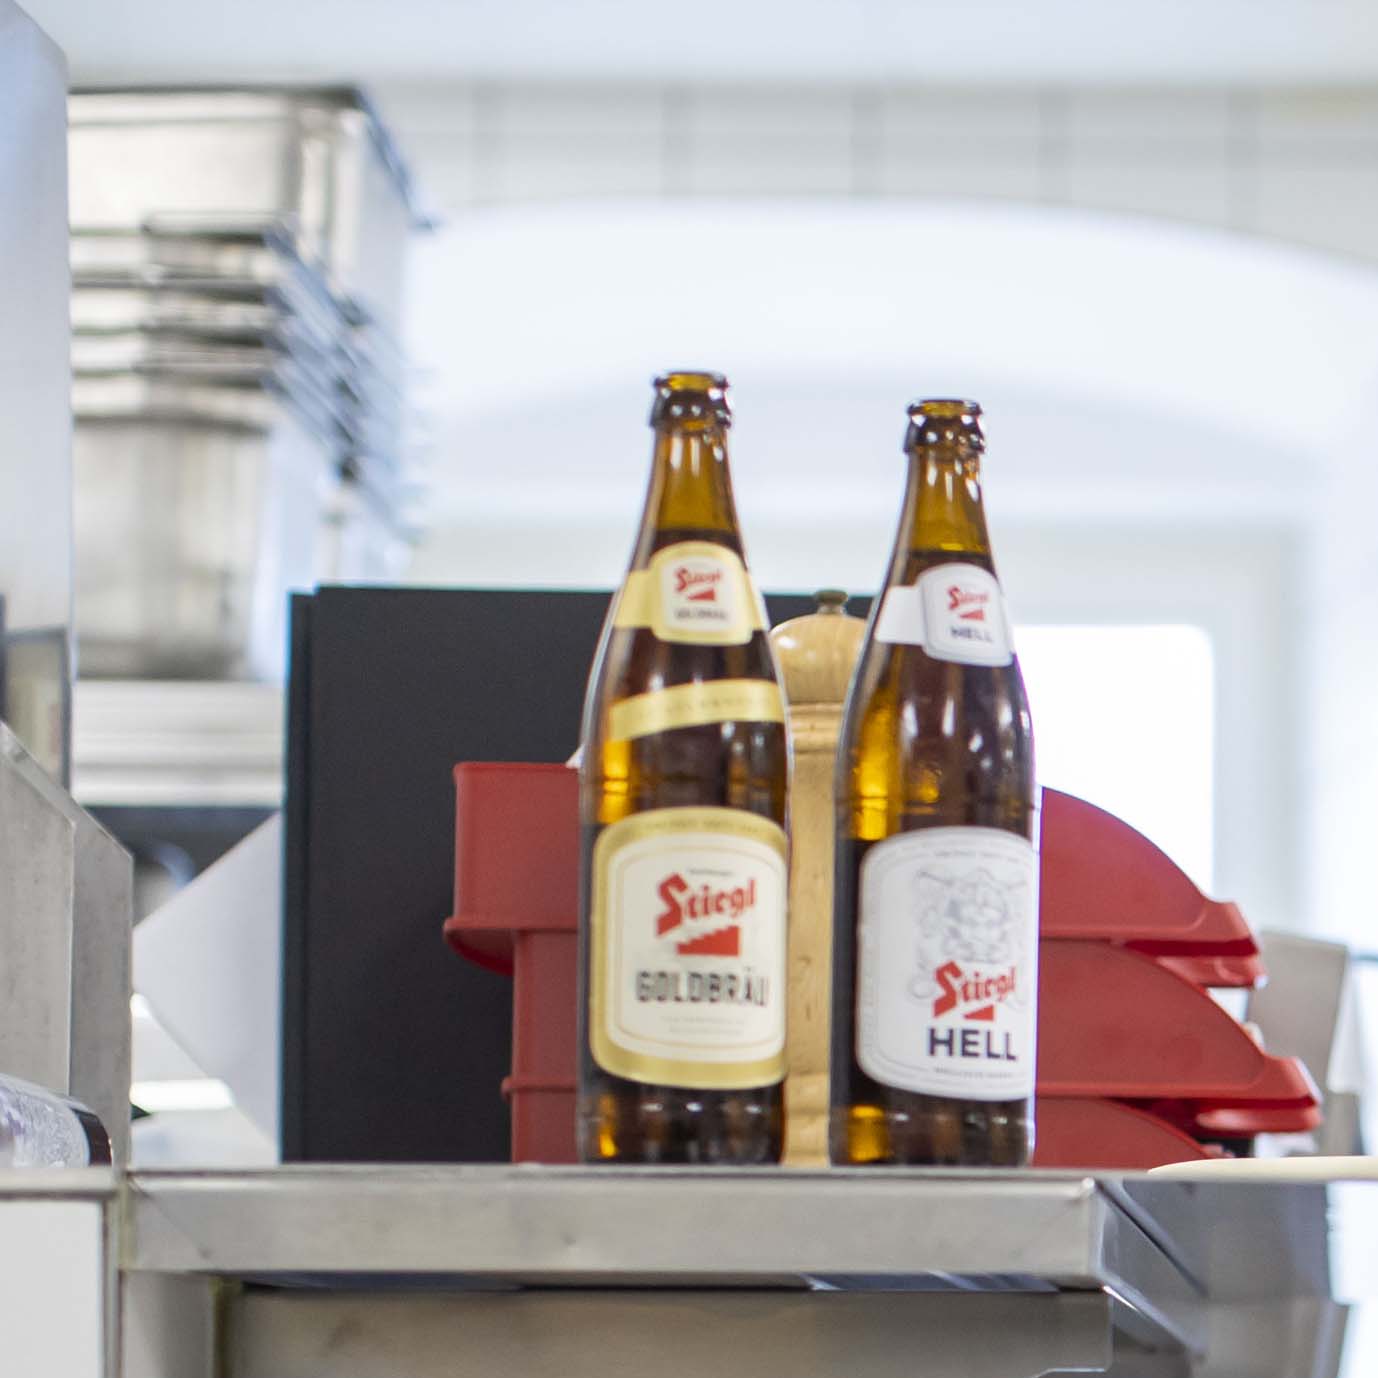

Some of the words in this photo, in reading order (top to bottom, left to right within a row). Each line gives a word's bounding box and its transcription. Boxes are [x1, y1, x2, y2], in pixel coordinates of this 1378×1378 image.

[656, 872, 757, 938] Stiegl
[932, 960, 1017, 1019] Stiegl
[928, 1027, 1018, 1062] HELL
